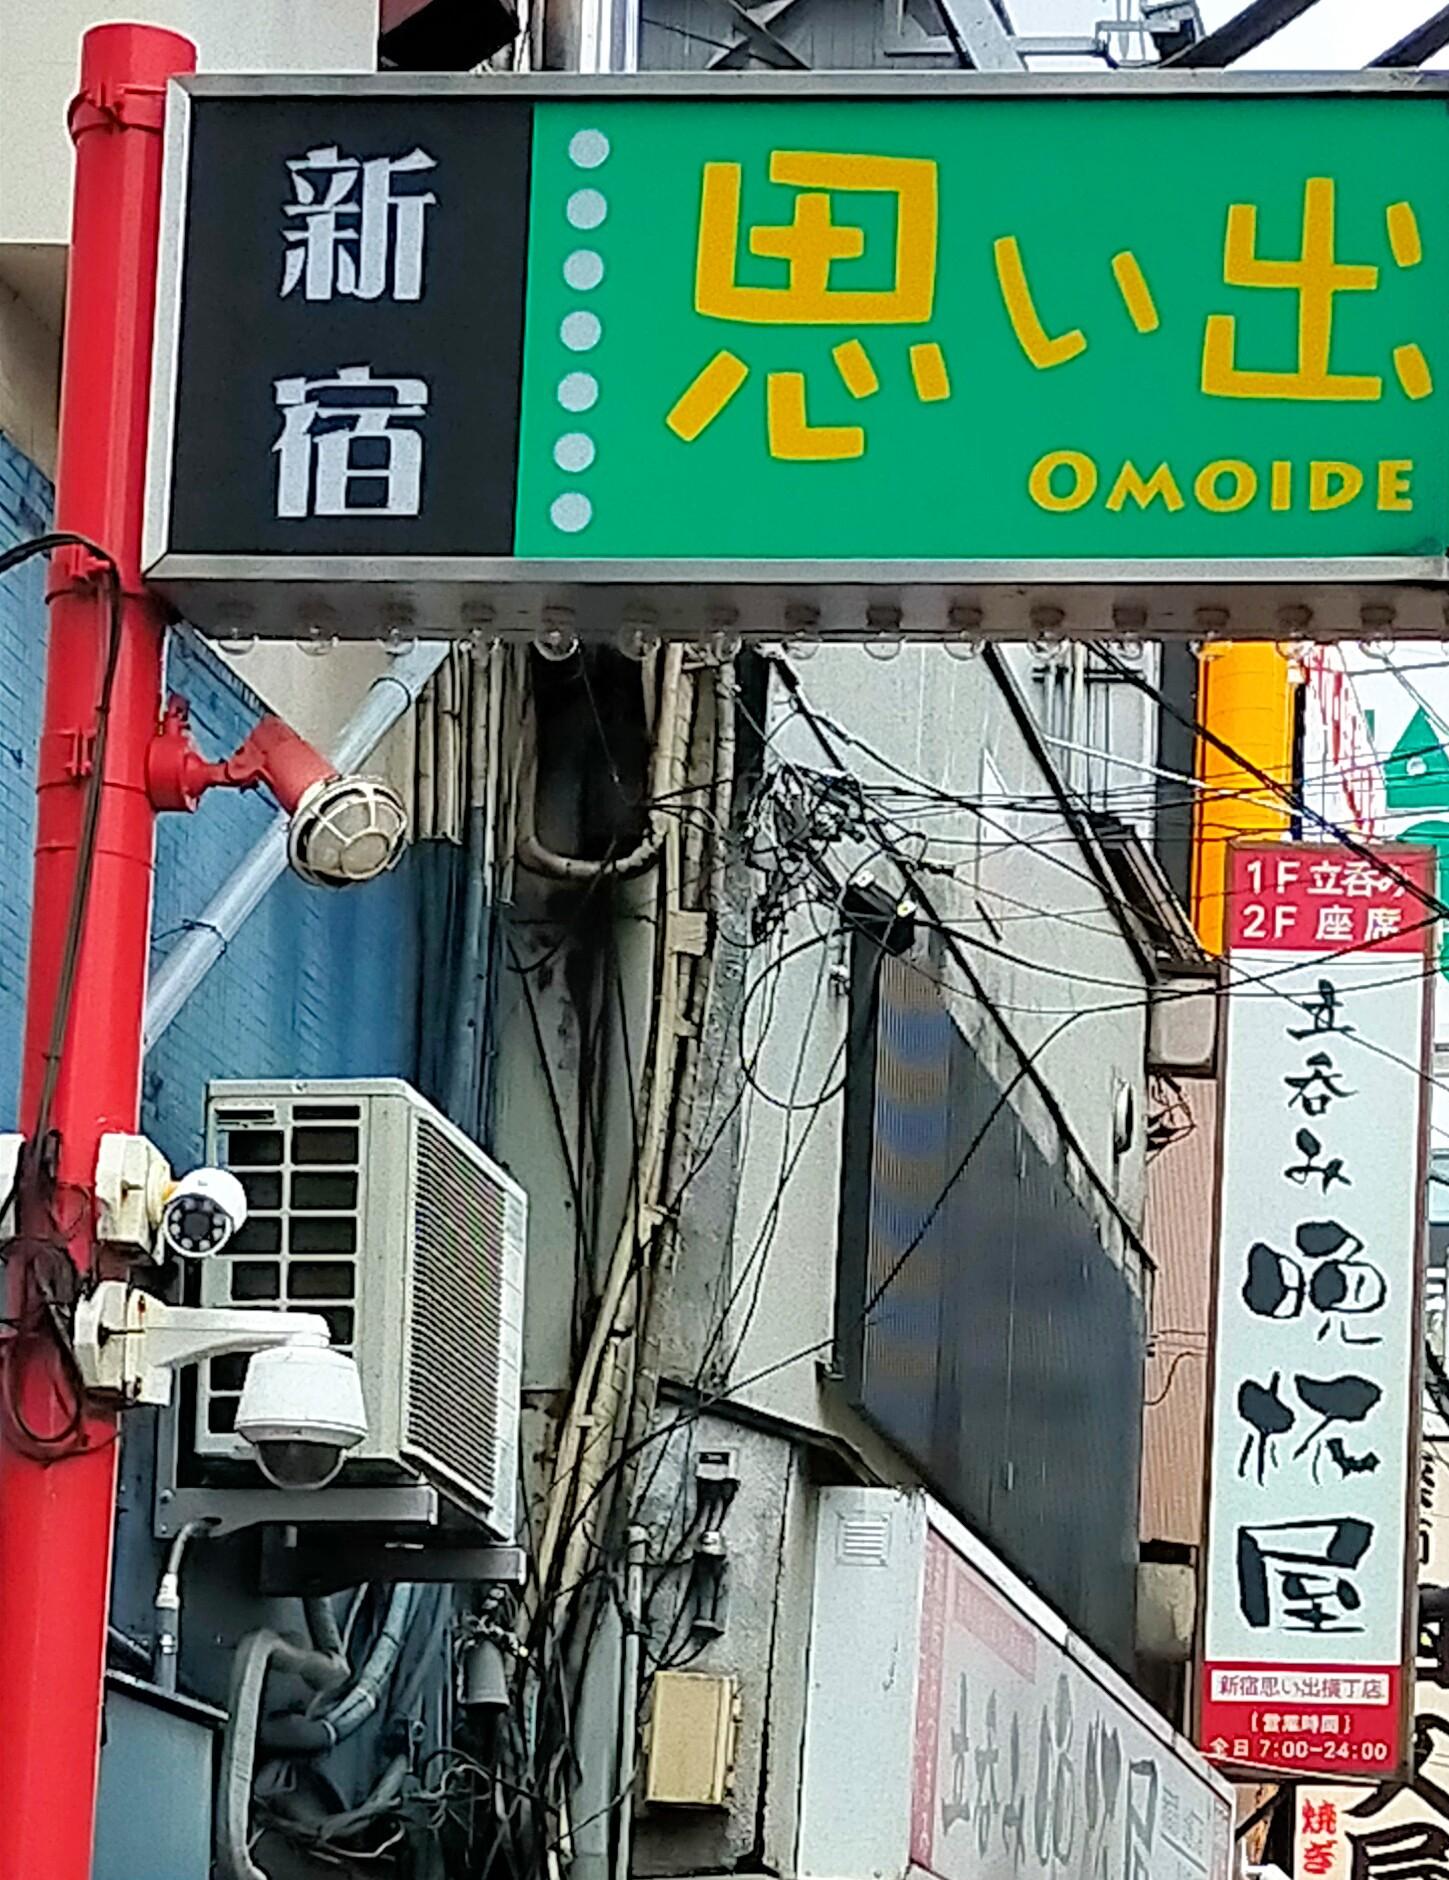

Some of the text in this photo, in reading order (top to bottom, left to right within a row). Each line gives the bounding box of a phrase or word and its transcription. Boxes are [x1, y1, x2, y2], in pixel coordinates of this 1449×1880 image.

[276, 145, 437, 519] 新宿
[1028, 450, 1414, 513] OMOIDE
[1247, 859, 1301, 894] 1F
[1243, 904, 1402, 941] 2F 座席
[1285, 978, 1356, 1193] 立呑み
[1219, 1674, 1386, 1699] 新宿思い出横丁店
